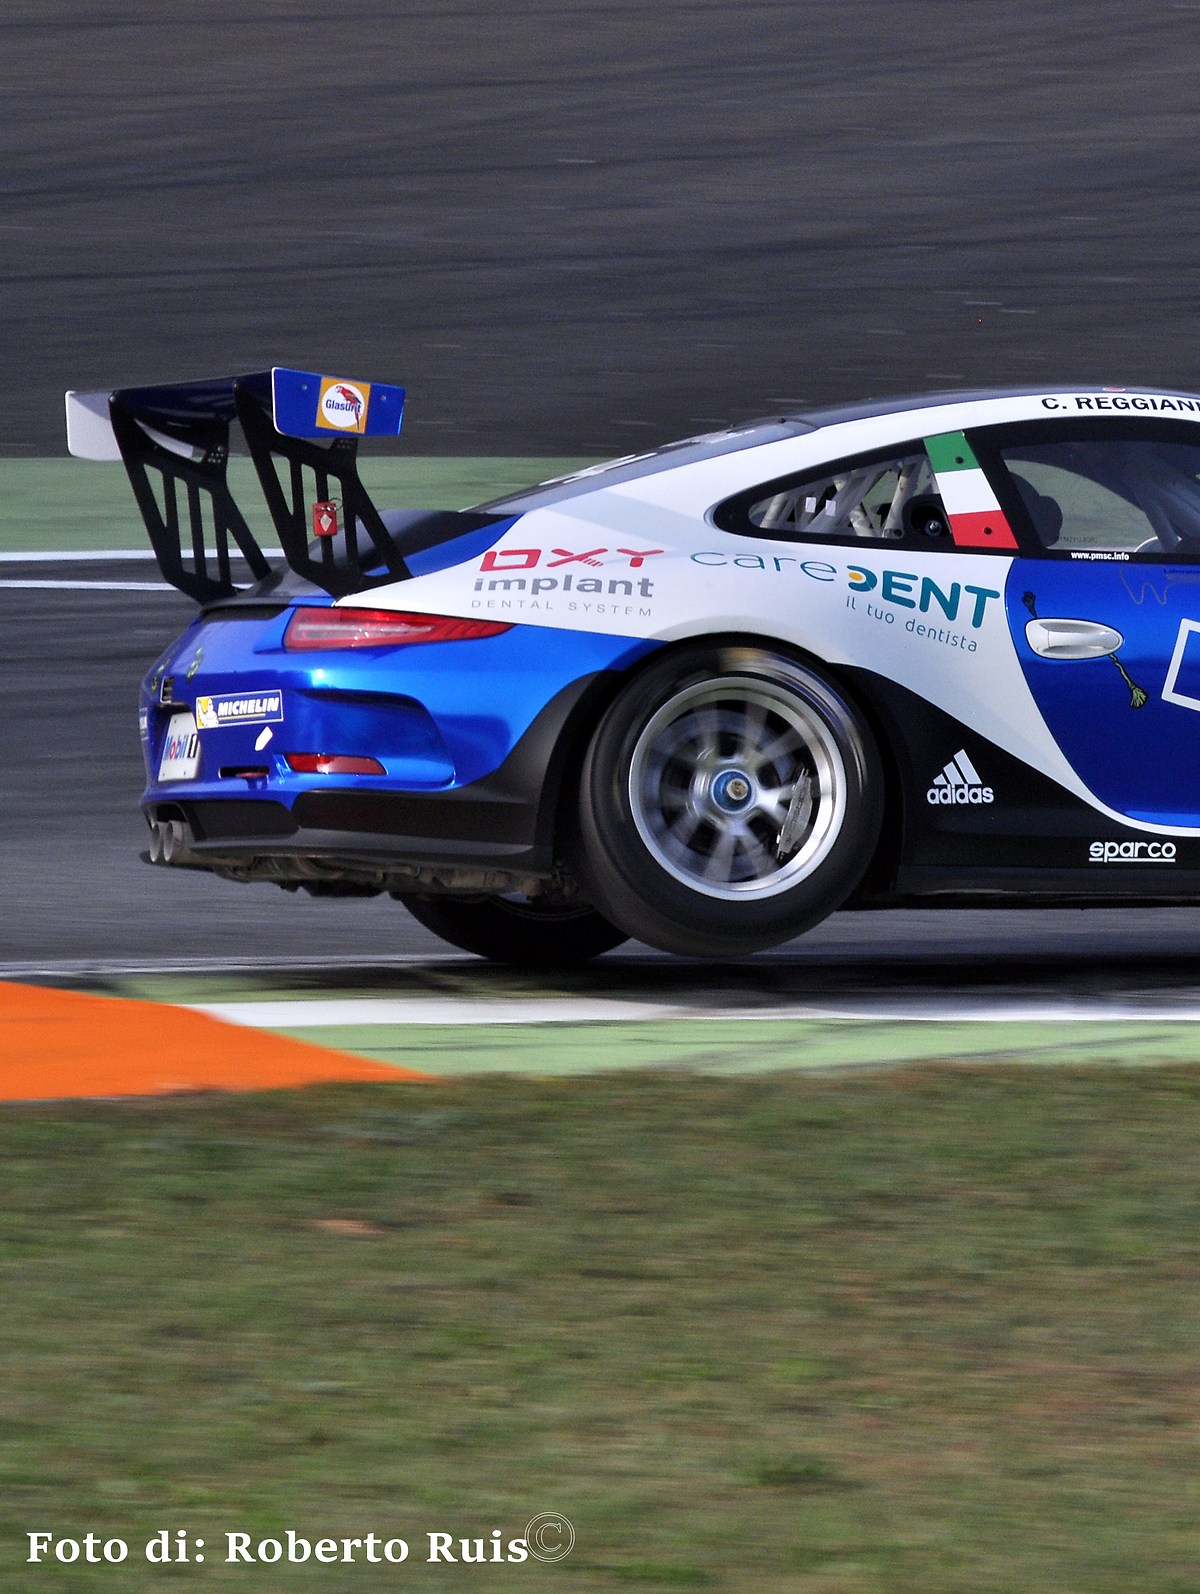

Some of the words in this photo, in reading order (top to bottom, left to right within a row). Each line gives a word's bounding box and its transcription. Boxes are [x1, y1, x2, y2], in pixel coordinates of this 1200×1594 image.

[1041, 397, 1068, 411] C.
[1070, 551, 1130, 561] www.pmsc.info
[474, 574, 654, 598] implant
[471, 599, 554, 610] DENTAL
[568, 602, 652, 617] SYSTEM
[846, 595, 856, 611] il
[867, 602, 895, 624] tuo
[905, 618, 978, 653] dentista
[217, 697, 280, 717] MICHELIN
[926, 784, 995, 805] adidas
[1089, 841, 1176, 862] sparco
